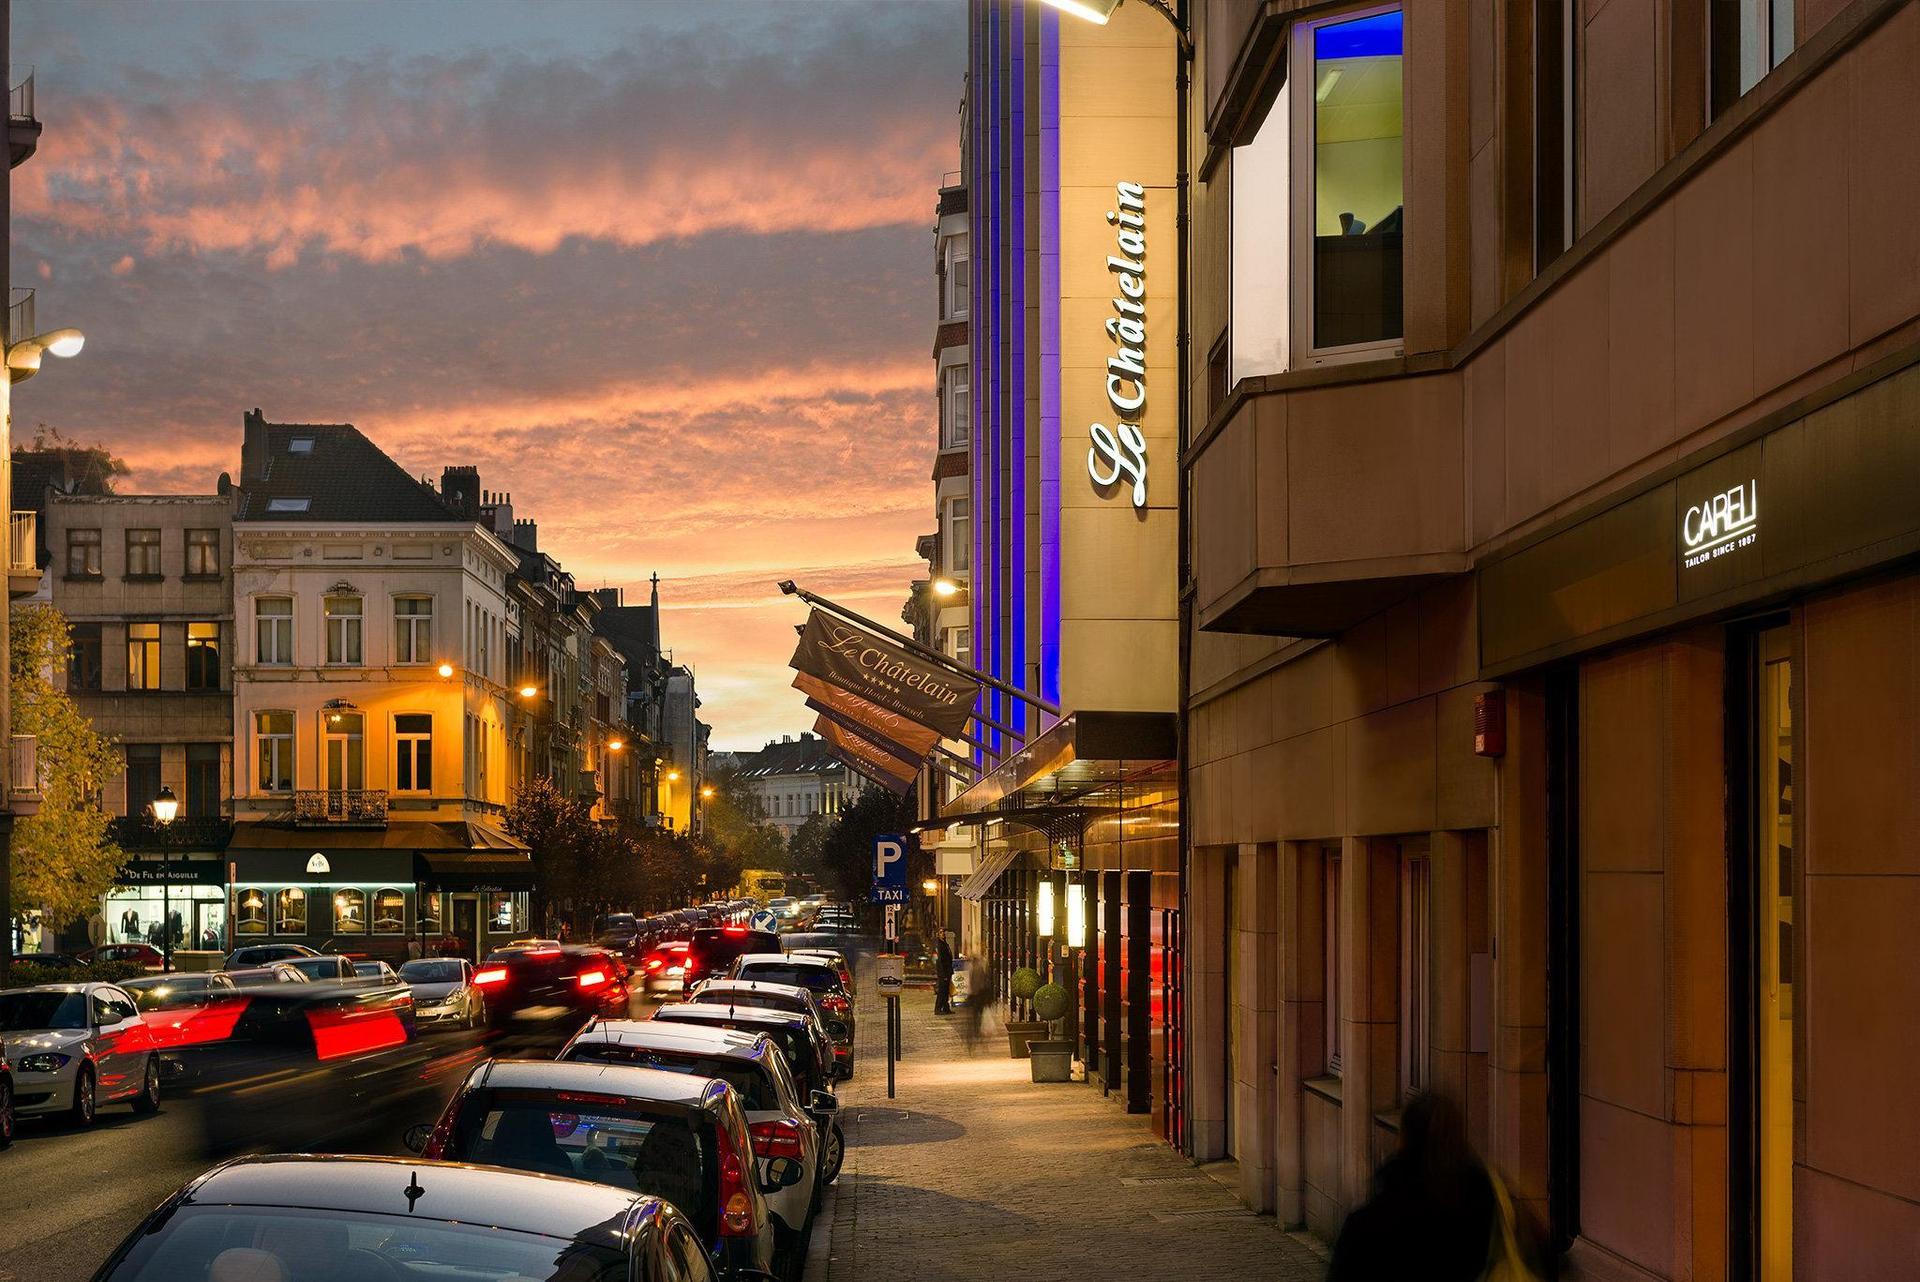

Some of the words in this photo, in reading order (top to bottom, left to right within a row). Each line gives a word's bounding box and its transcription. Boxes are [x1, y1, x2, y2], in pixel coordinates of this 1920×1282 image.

[1106, 181, 1146, 410] Châtelain
[1088, 422, 1147, 507] Le
[1685, 552, 1710, 568] TAILOR
[1712, 542, 1735, 558] SINCE
[818, 627, 863, 658] Le
[860, 648, 958, 705] Châtelain
[877, 841, 902, 878] P
[877, 890, 903, 900] TAXI
